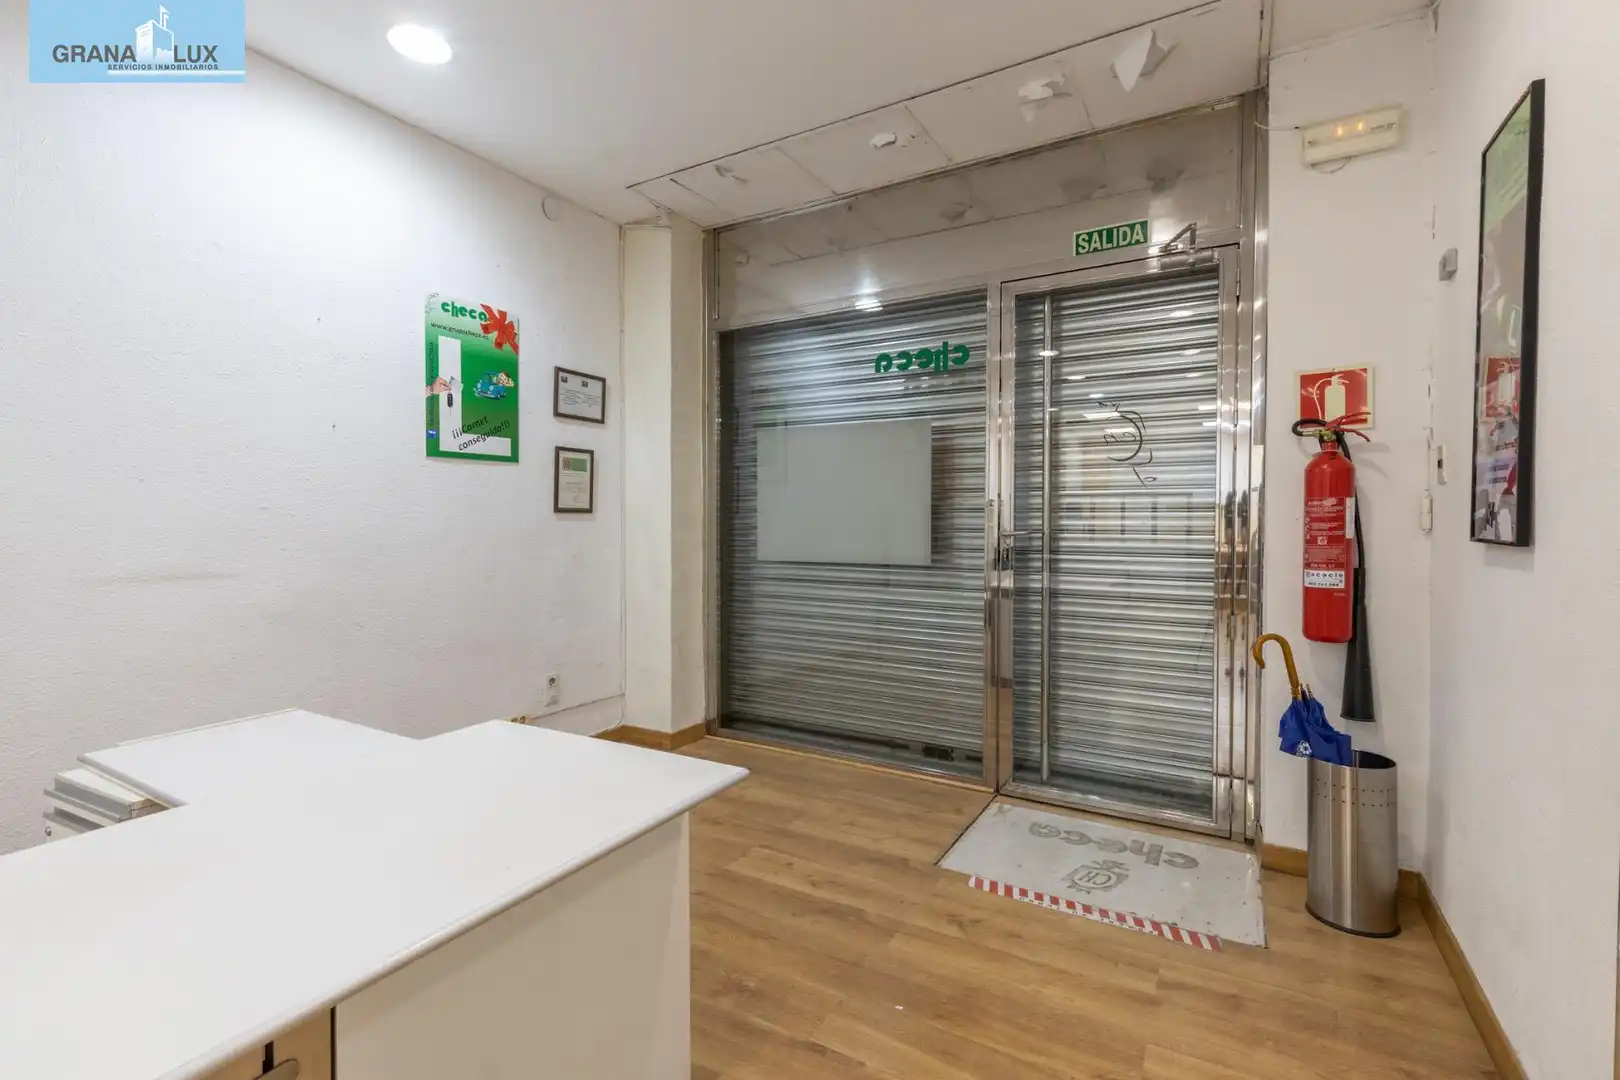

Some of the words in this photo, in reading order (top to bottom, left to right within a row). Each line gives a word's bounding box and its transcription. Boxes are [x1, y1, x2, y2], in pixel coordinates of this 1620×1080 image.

[1078, 223, 1144, 253] SALIDA
[441, 301, 489, 322] checa
[1028, 821, 1200, 869] checa
